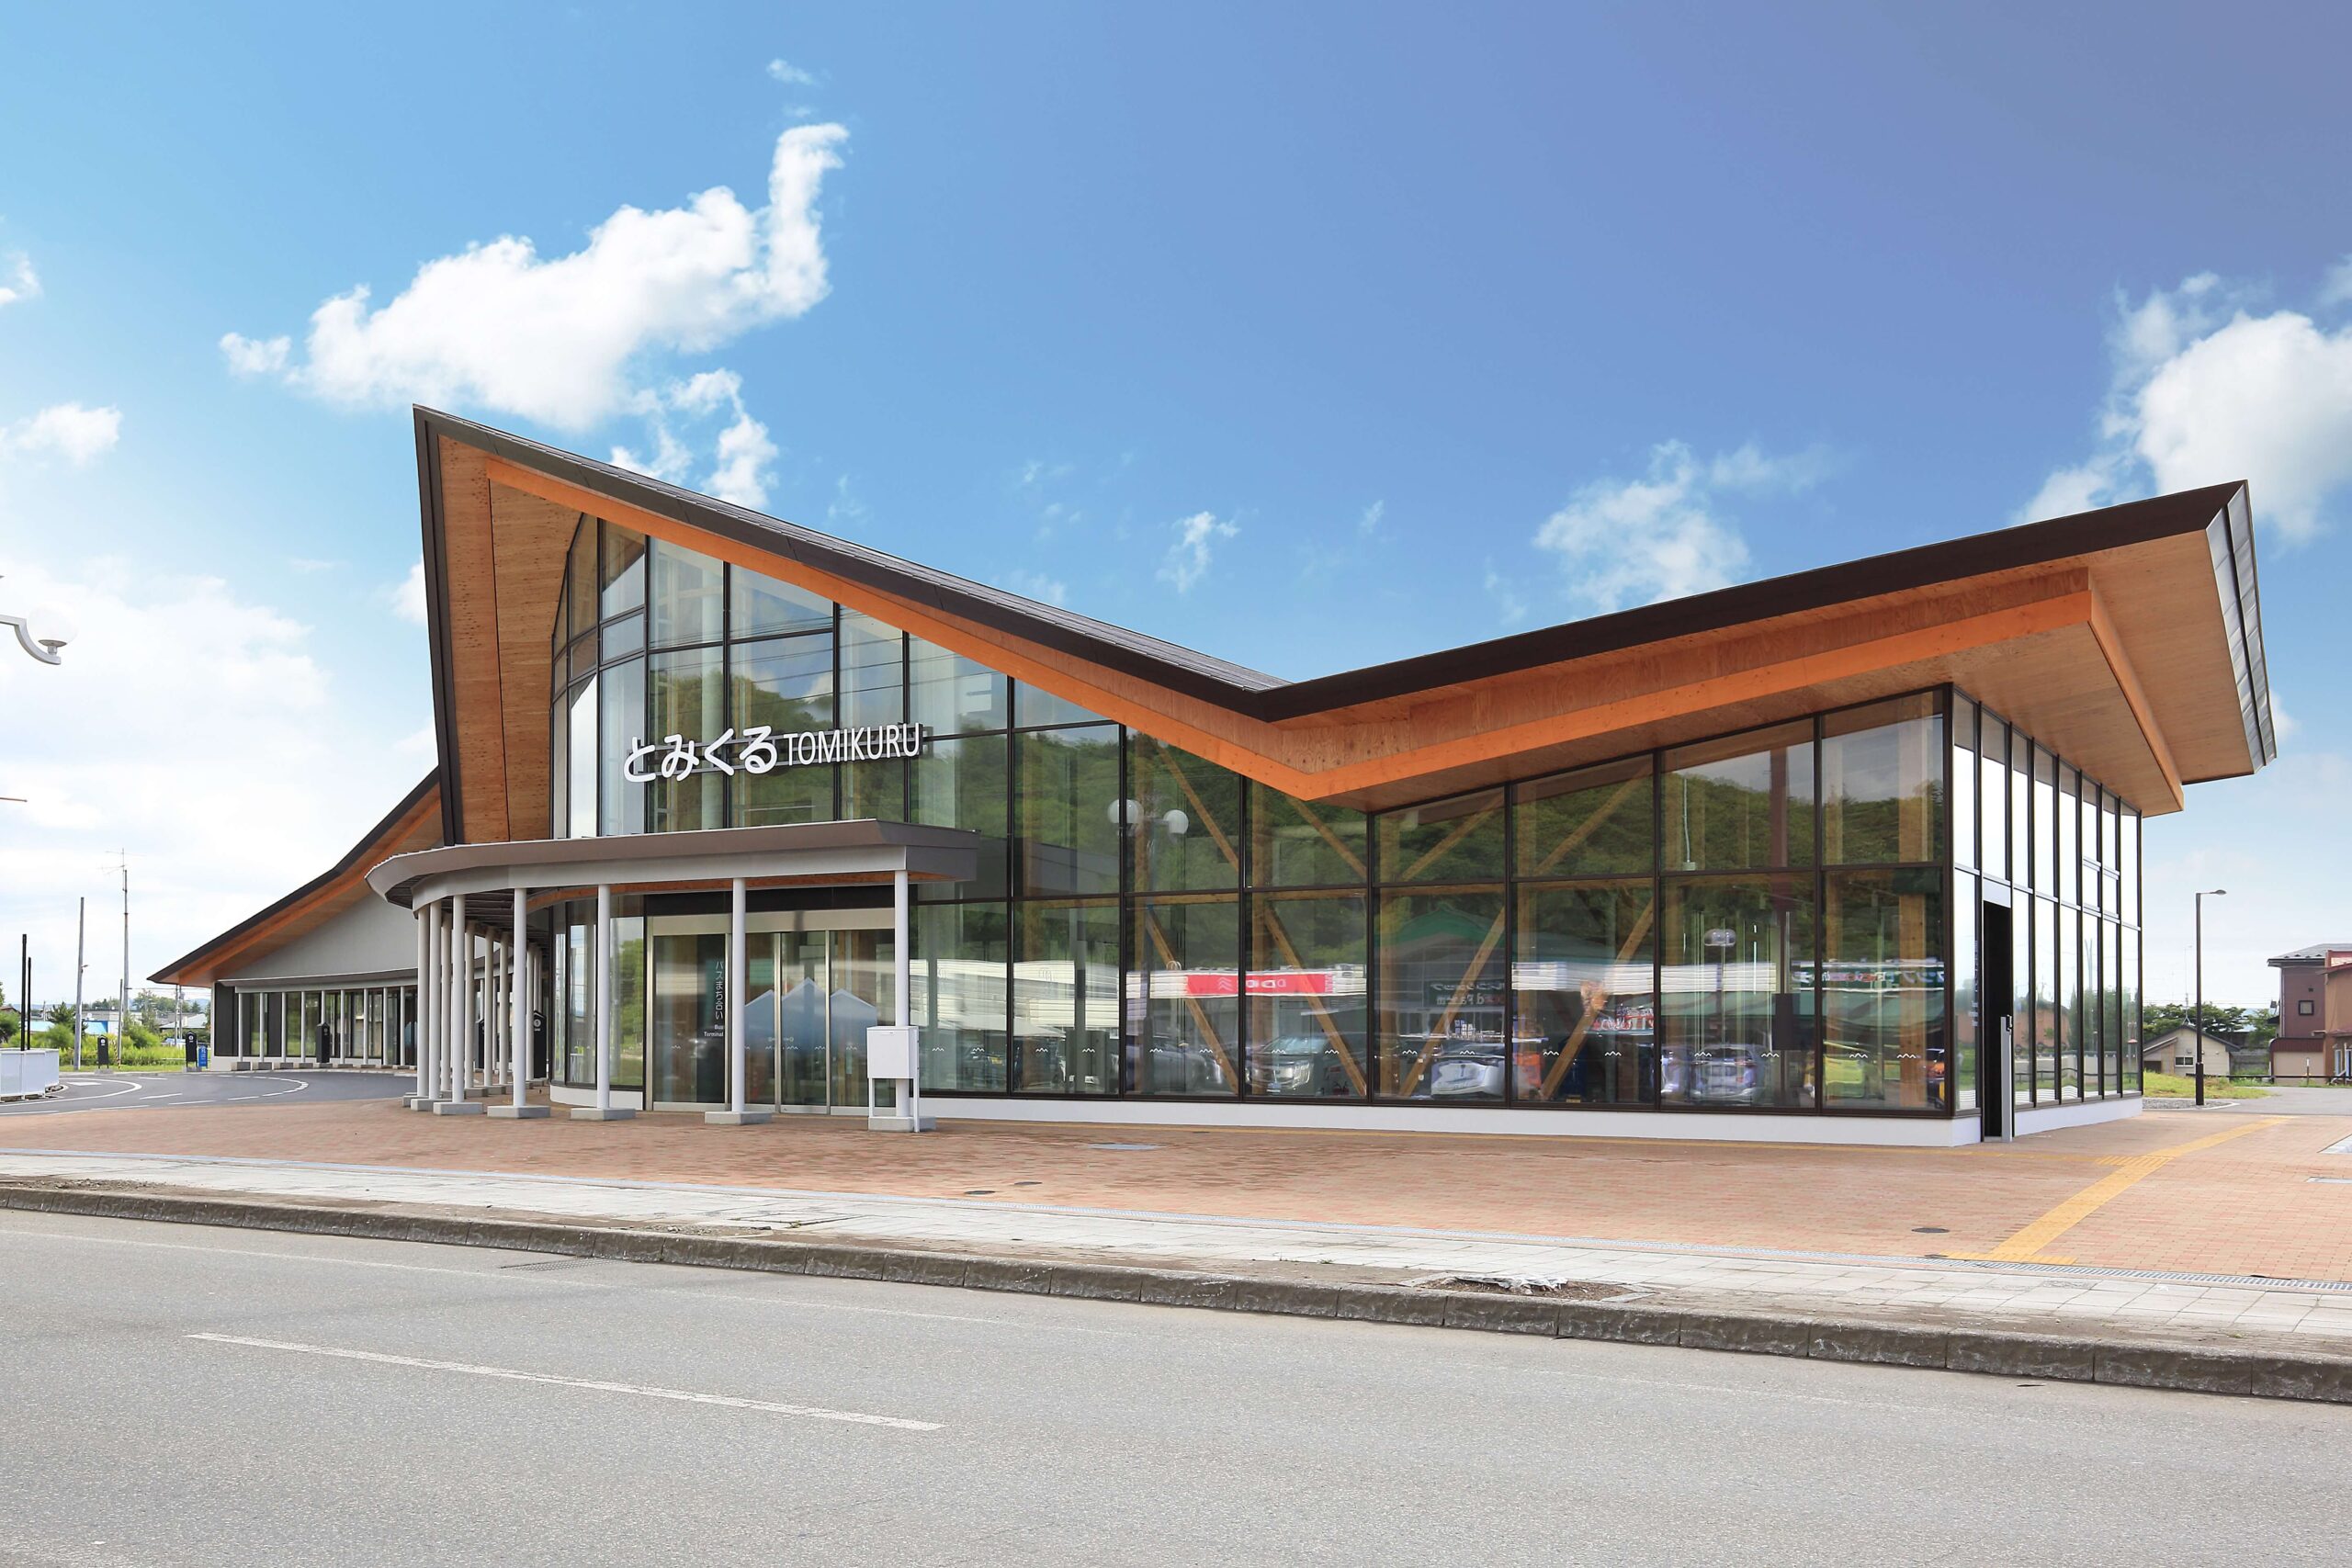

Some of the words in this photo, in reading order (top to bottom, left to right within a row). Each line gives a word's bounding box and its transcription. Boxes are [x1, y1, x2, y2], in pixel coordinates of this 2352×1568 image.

[623, 725, 778, 783] とみくる
[784, 722, 920, 766] TOMIKURU
